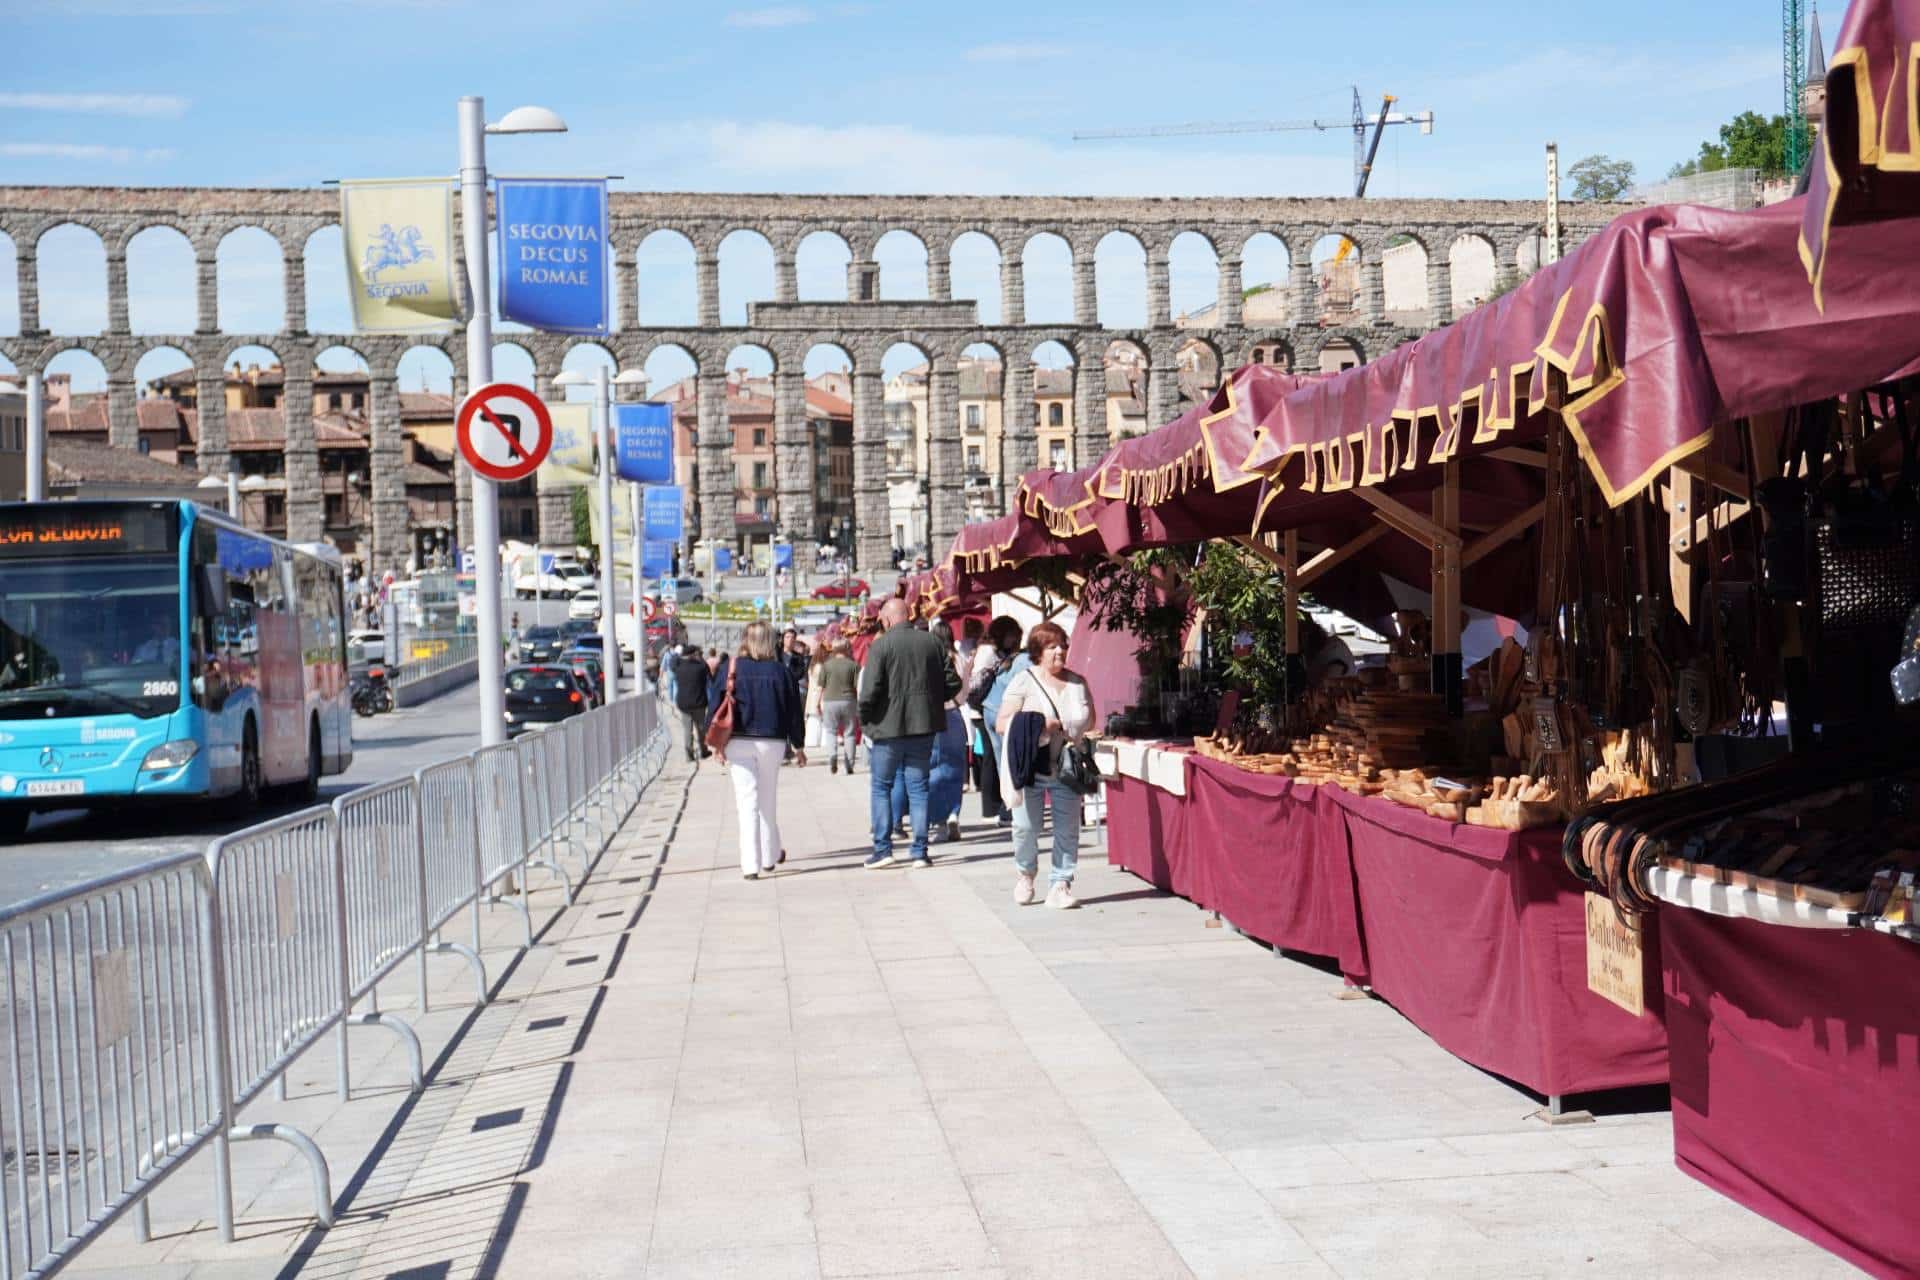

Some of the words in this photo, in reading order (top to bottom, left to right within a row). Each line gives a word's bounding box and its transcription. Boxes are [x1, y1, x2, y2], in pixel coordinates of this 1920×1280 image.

[508, 222, 598, 243] SEGOVIA
[519, 245, 589, 264] DECUS
[520, 267, 590, 286] ROMAE
[366, 281, 430, 299] SEGOVIA
[621, 425, 668, 437] SEGOVIA
